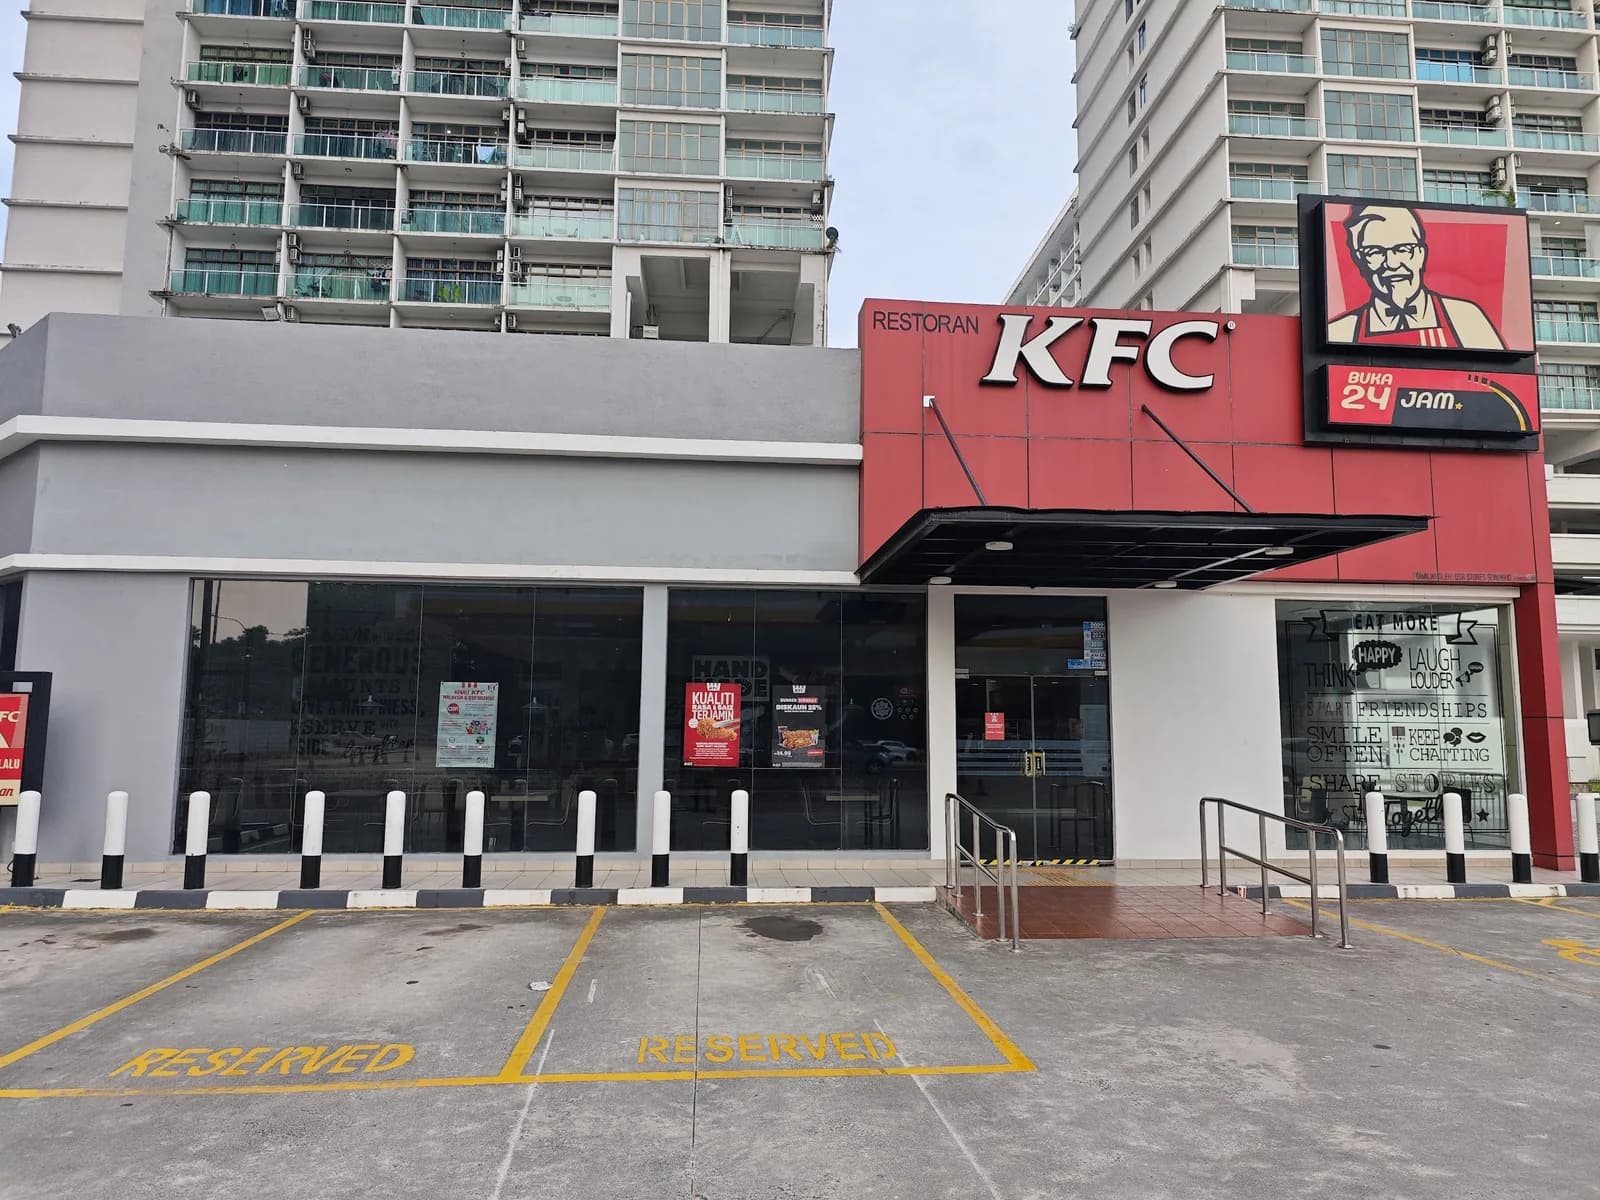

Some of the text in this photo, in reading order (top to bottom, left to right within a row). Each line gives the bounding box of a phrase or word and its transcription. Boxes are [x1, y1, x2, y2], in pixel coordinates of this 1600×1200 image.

[872, 311, 979, 335] RESTORAN
[979, 313, 1220, 393] KFC
[1348, 371, 1394, 385] BUKA
[1341, 385, 1456, 411] 24 JAM
[1355, 613, 1438, 632] EAT MORE
[1304, 646, 1396, 688] THINK HAPPY
[1408, 648, 1461, 672] LAUGH
[694, 660, 769, 679] HAND
[1409, 671, 1455, 689] LOUDER
[692, 692, 735, 705] KUALITI
[0, 711, 21, 723] FC
[692, 710, 735, 720] TERJAMIN
[1357, 702, 1488, 718] FRIENDSHIPS
[1306, 726, 1382, 744] SMILE
[1408, 728, 1440, 746] KEEP
[1306, 745, 1383, 762] OFTEN
[1409, 748, 1490, 762] CHATTING
[0, 758, 20, 769] LALU
[0, 788, 14, 797] an
[1310, 774, 1382, 793] SHARE
[636, 1032, 898, 1064] RESERVED
[109, 1043, 416, 1078] RESERVED
